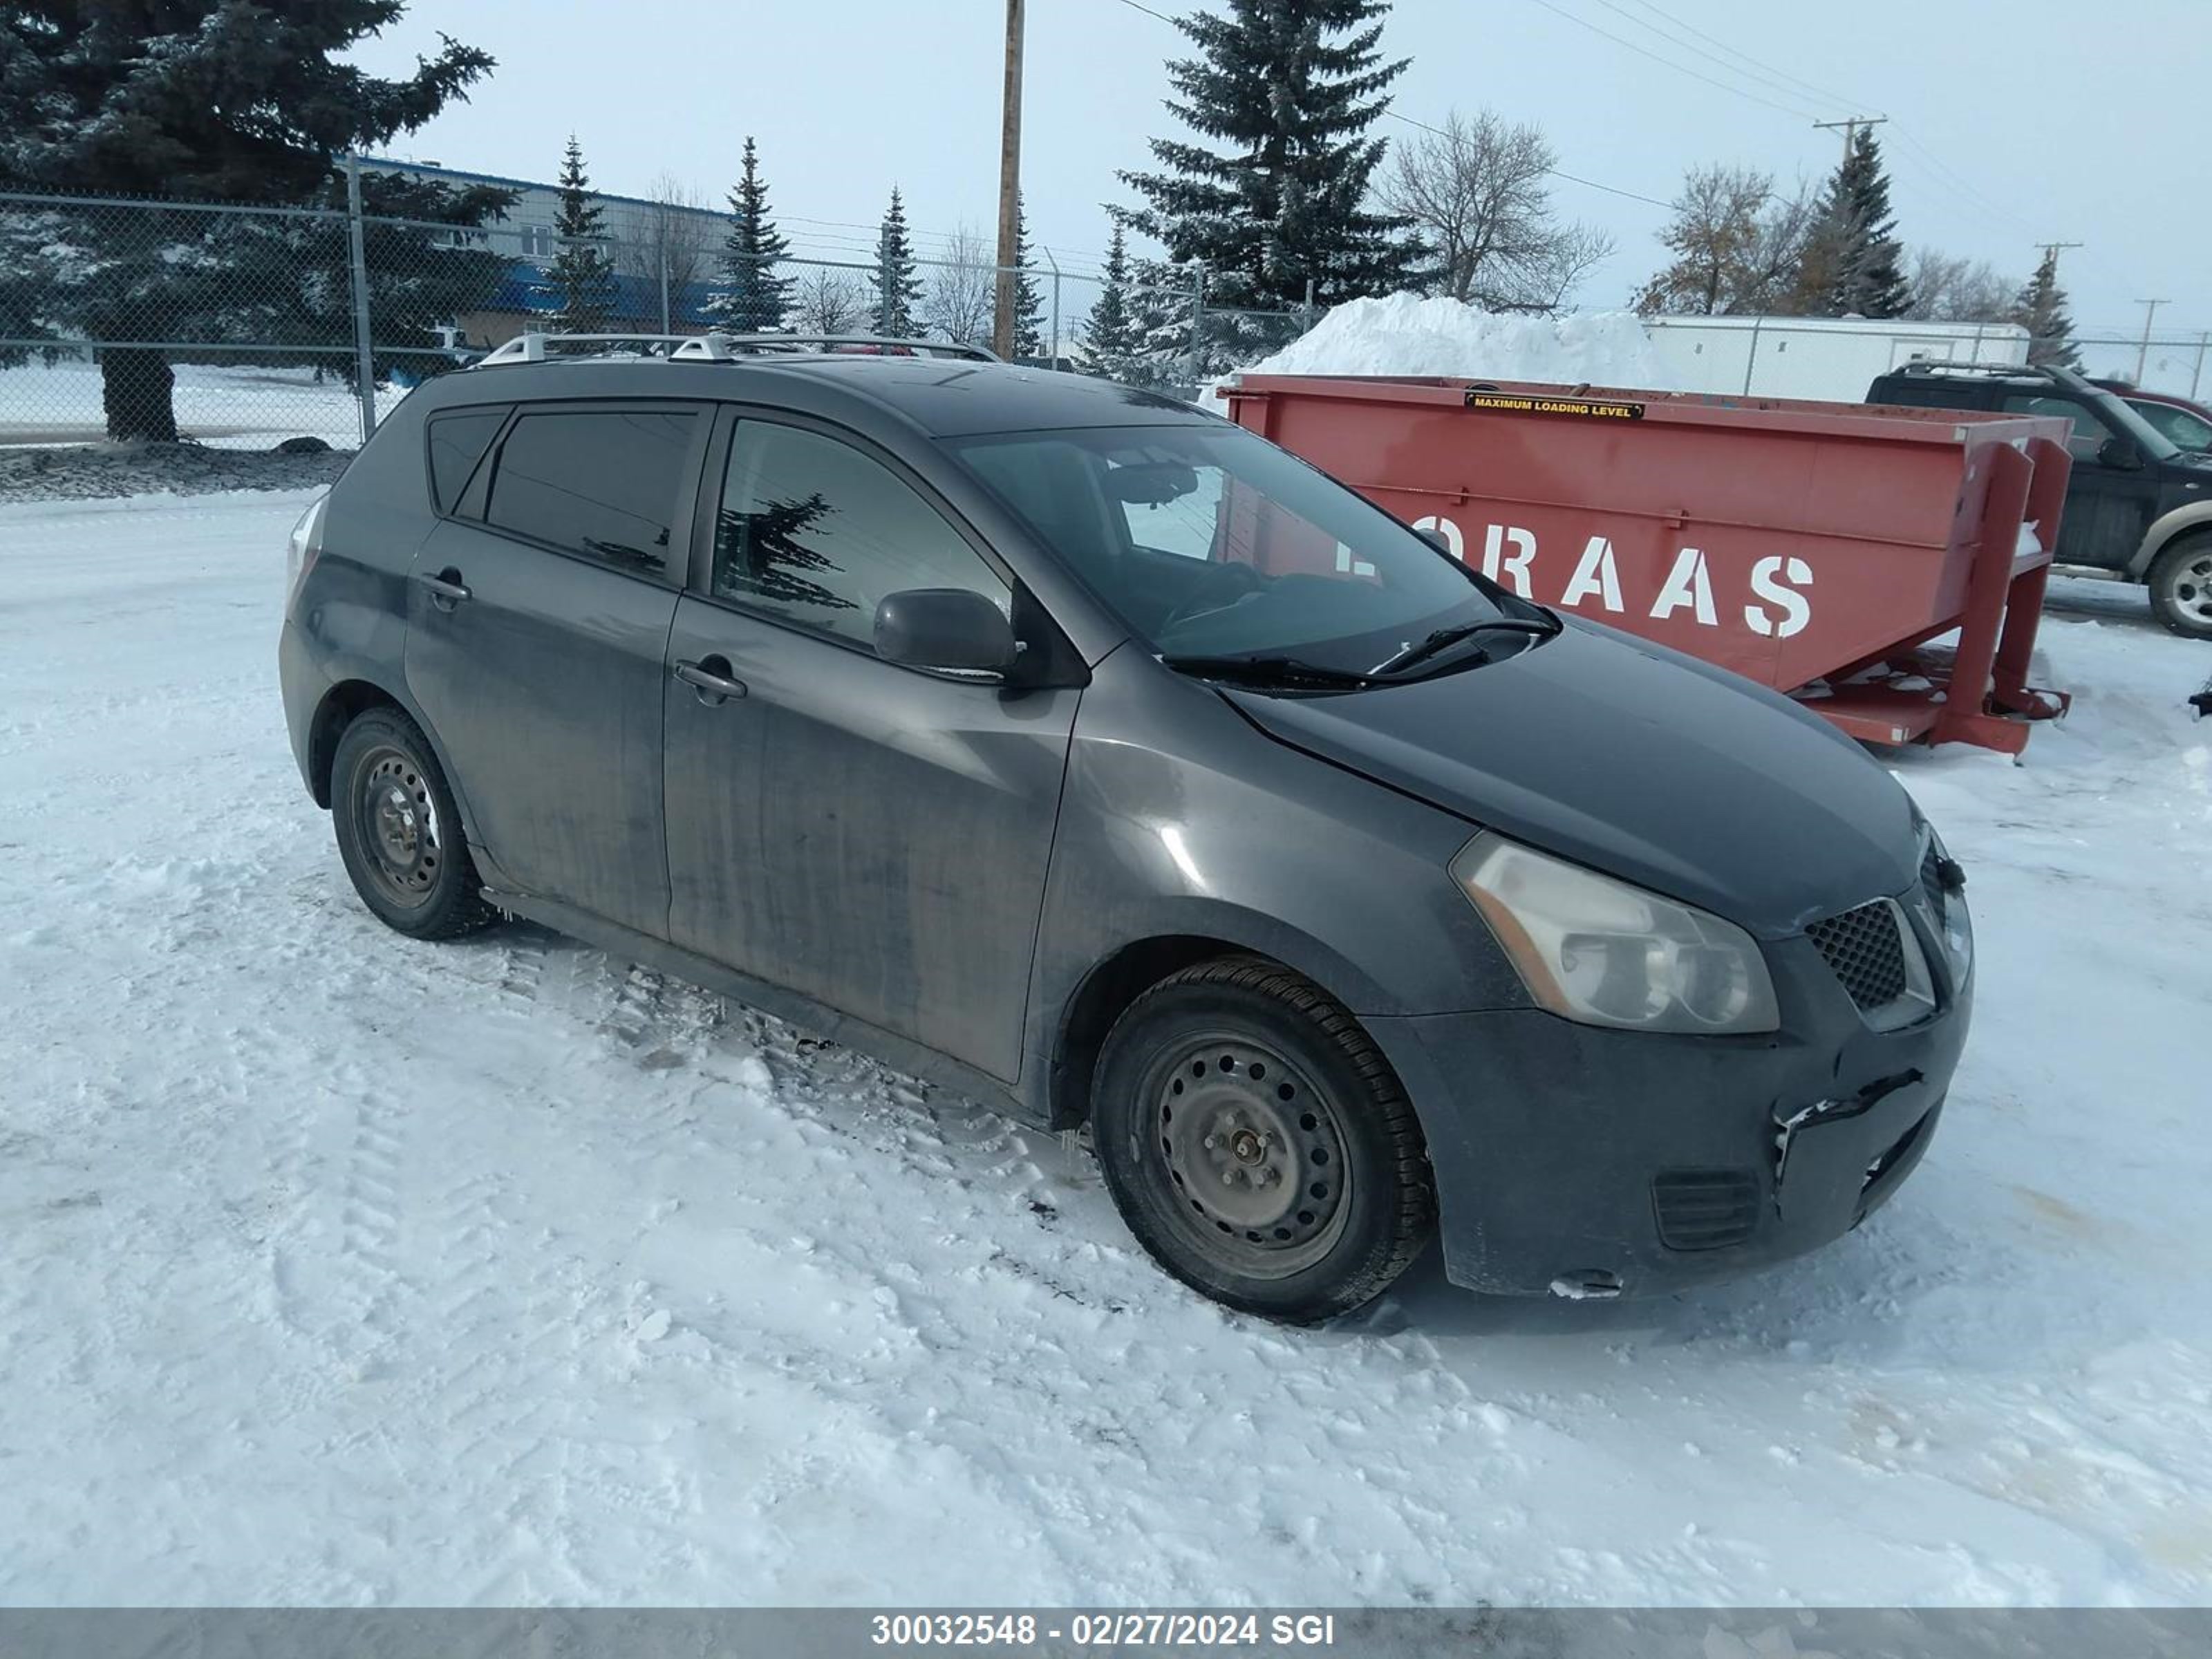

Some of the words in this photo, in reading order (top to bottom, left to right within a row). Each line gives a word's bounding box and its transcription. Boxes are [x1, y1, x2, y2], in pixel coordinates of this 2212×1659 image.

[1474, 397, 1532, 410] MAXIMUM
[1535, 401, 1588, 414] LOADING
[1591, 406, 1631, 418] LEVEL
